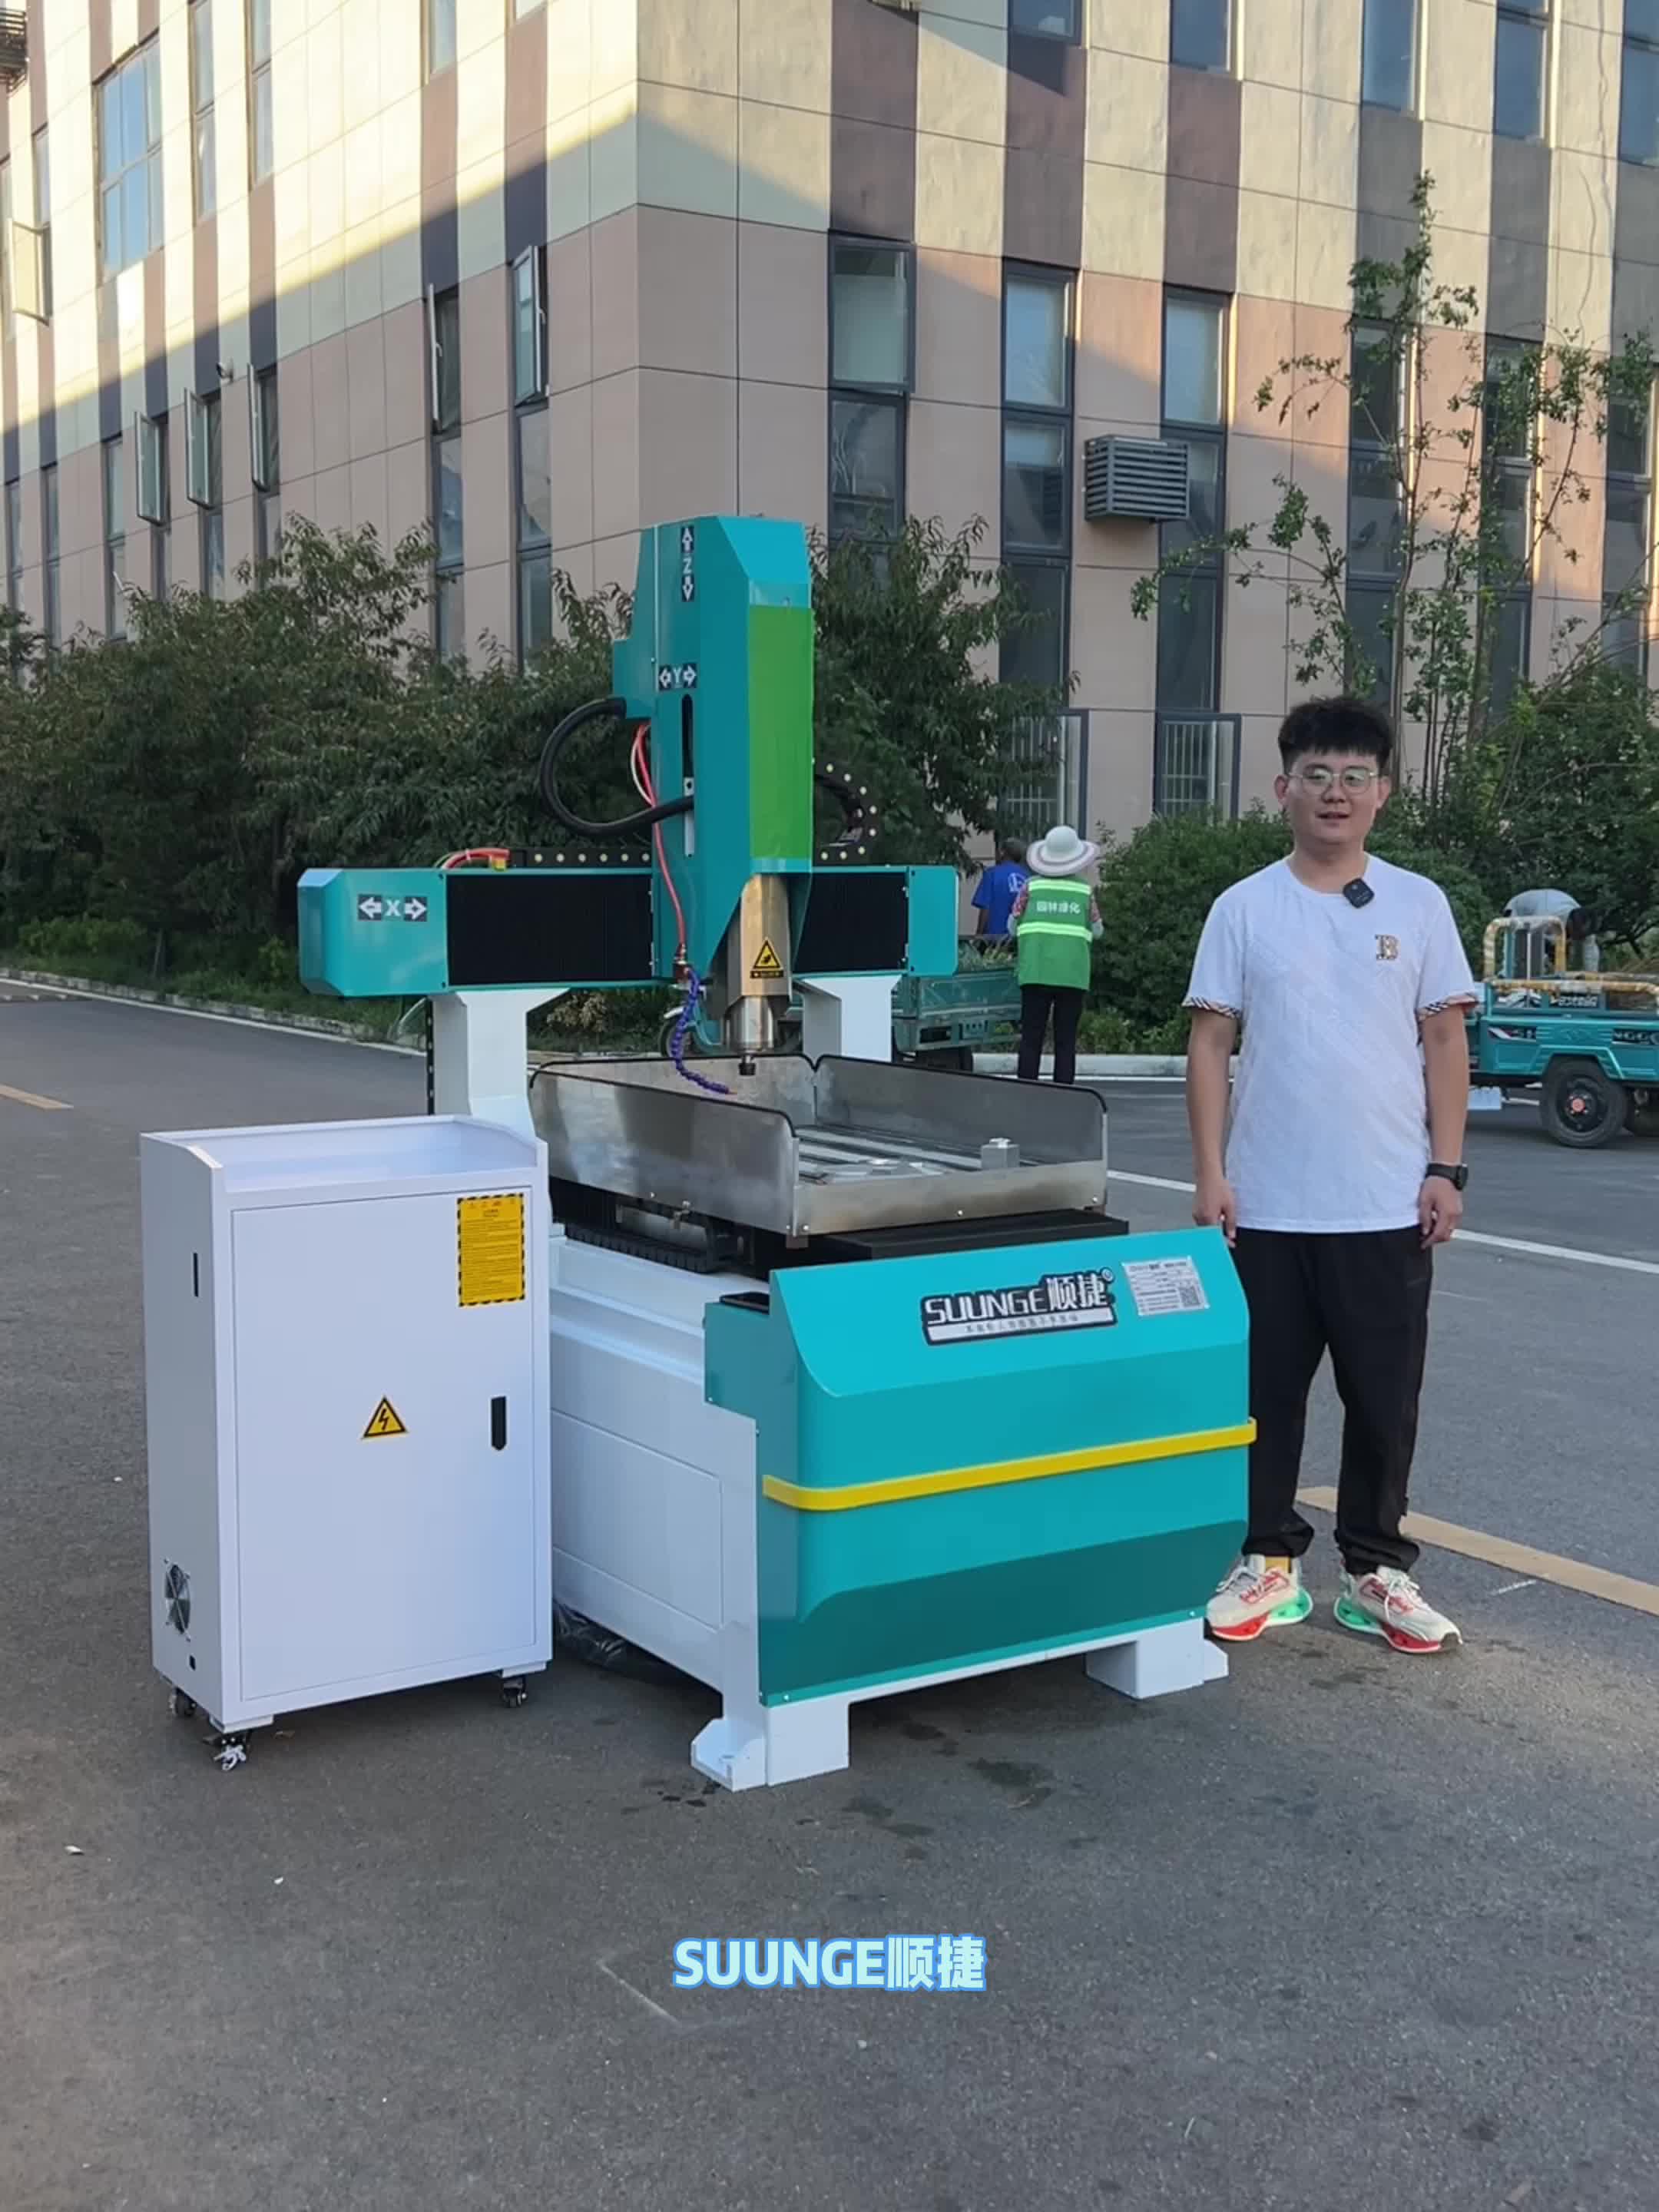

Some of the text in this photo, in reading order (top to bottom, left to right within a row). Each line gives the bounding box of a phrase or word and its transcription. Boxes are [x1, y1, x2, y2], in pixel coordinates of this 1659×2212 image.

[683, 558, 693, 575] Z
[673, 666, 683, 685] Y
[385, 899, 401, 916] X
